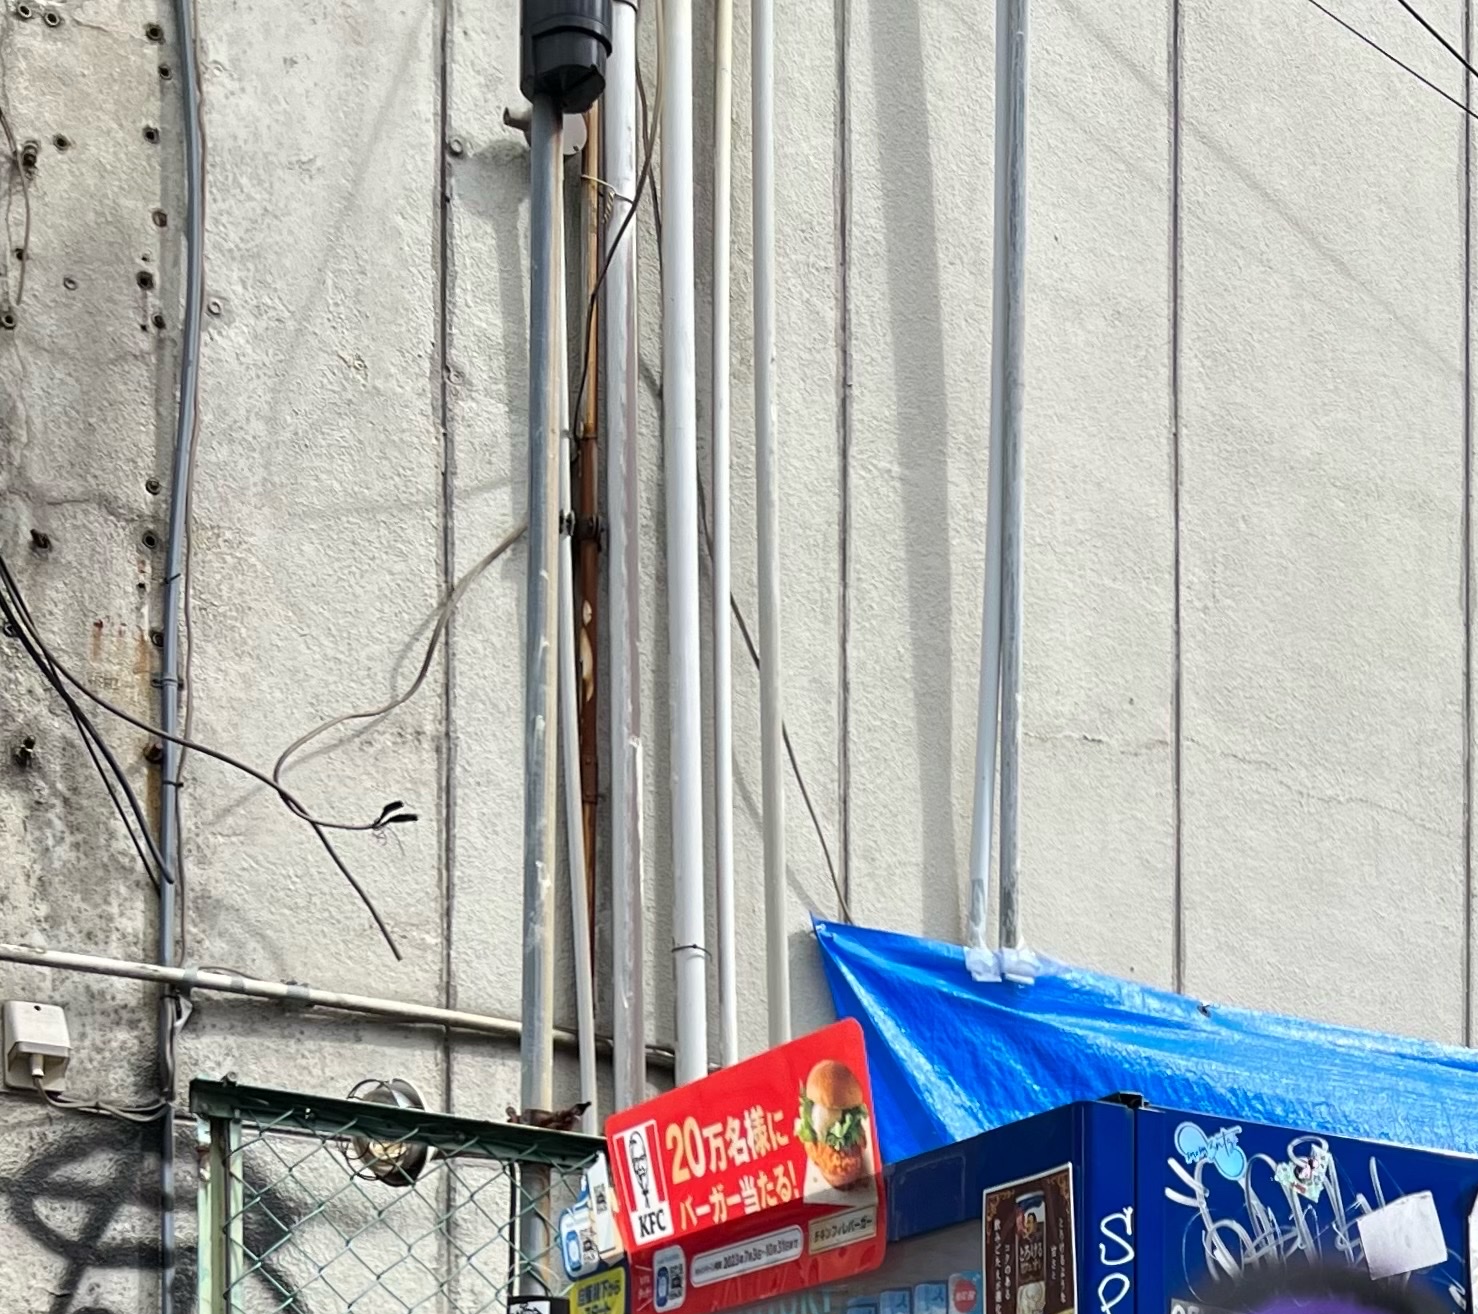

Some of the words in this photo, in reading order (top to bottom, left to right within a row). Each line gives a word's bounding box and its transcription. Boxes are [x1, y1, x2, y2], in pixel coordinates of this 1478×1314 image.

[666, 1104, 789, 1185] 20万名様に
[639, 1209, 667, 1238] KFC
[679, 1160, 800, 1230] バーガー当たる!
